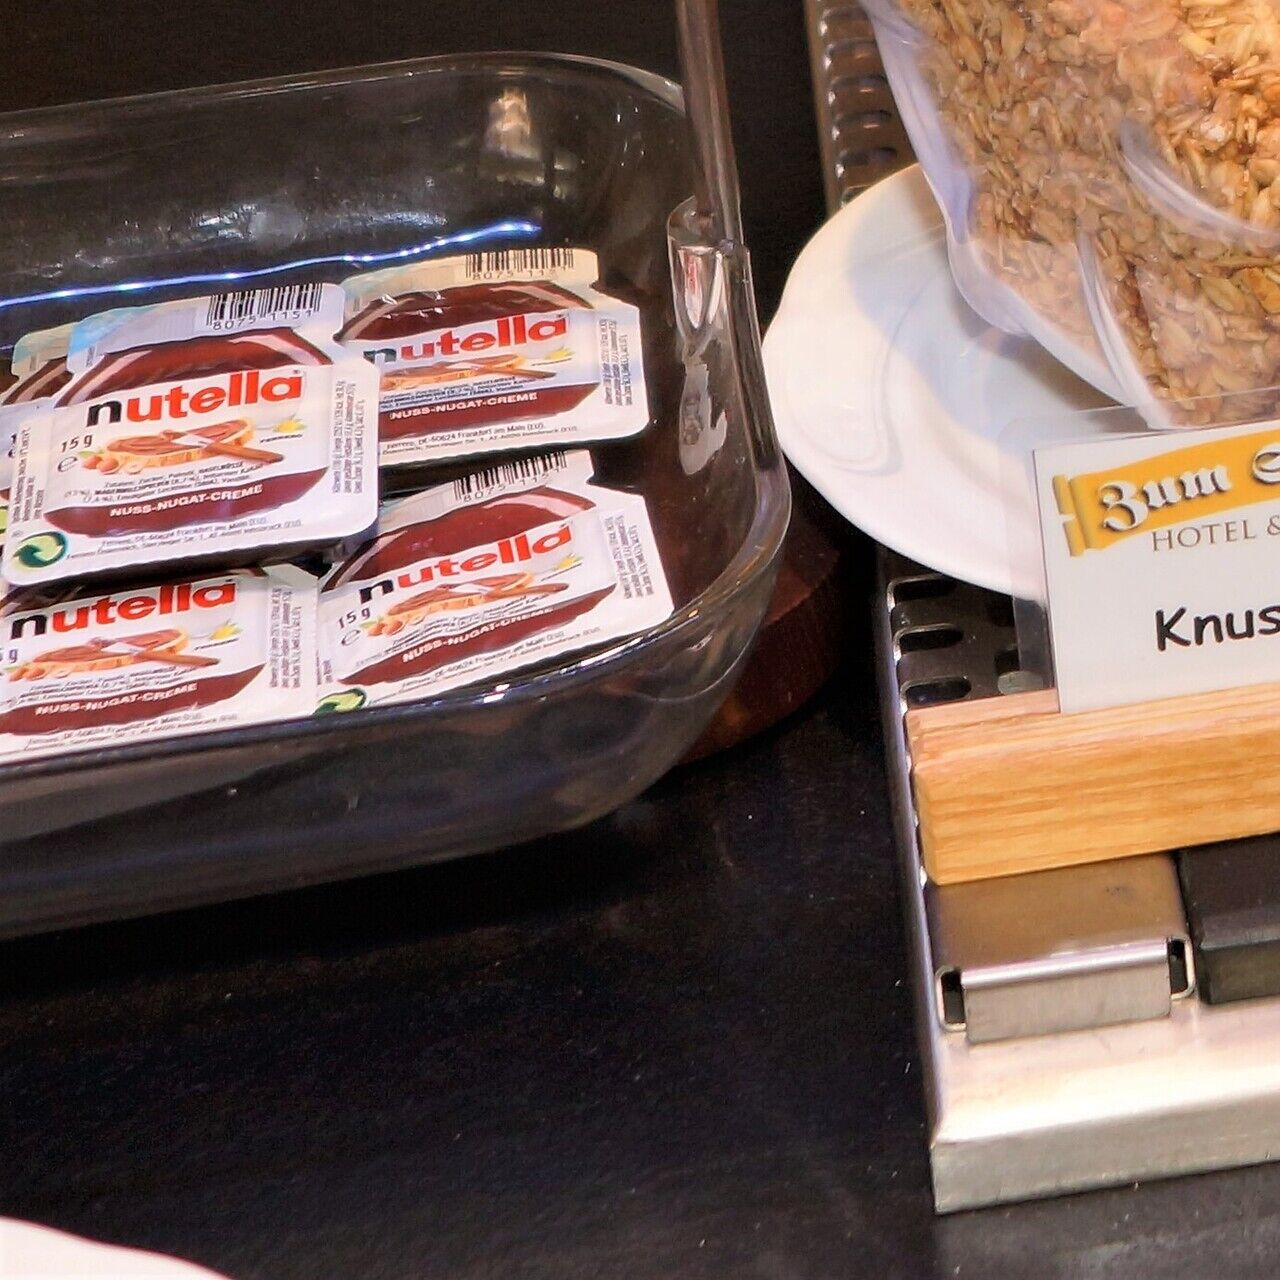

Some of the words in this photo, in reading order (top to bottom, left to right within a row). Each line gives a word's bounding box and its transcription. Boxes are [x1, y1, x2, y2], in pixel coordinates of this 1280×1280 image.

[213, 315, 256, 331] 8075
[271, 309, 313, 322] 1151
[364, 317, 567, 362] nutella
[86, 371, 303, 427] nutella
[389, 392, 538, 420] NUSS-NUGAT-CREME
[61, 436, 79, 454] 15
[83, 434, 94, 448] g
[110, 484, 263, 517] NUSS-NUGAT-CREME
[1098, 461, 1232, 533] Zum
[1151, 519, 1256, 553] HOTEL
[358, 525, 573, 604] nutella
[11, 583, 236, 640] nutella
[337, 612, 358, 630] 15
[361, 606, 372, 620] g
[35, 682, 198, 716] NUSS-NUGAT-CREME
